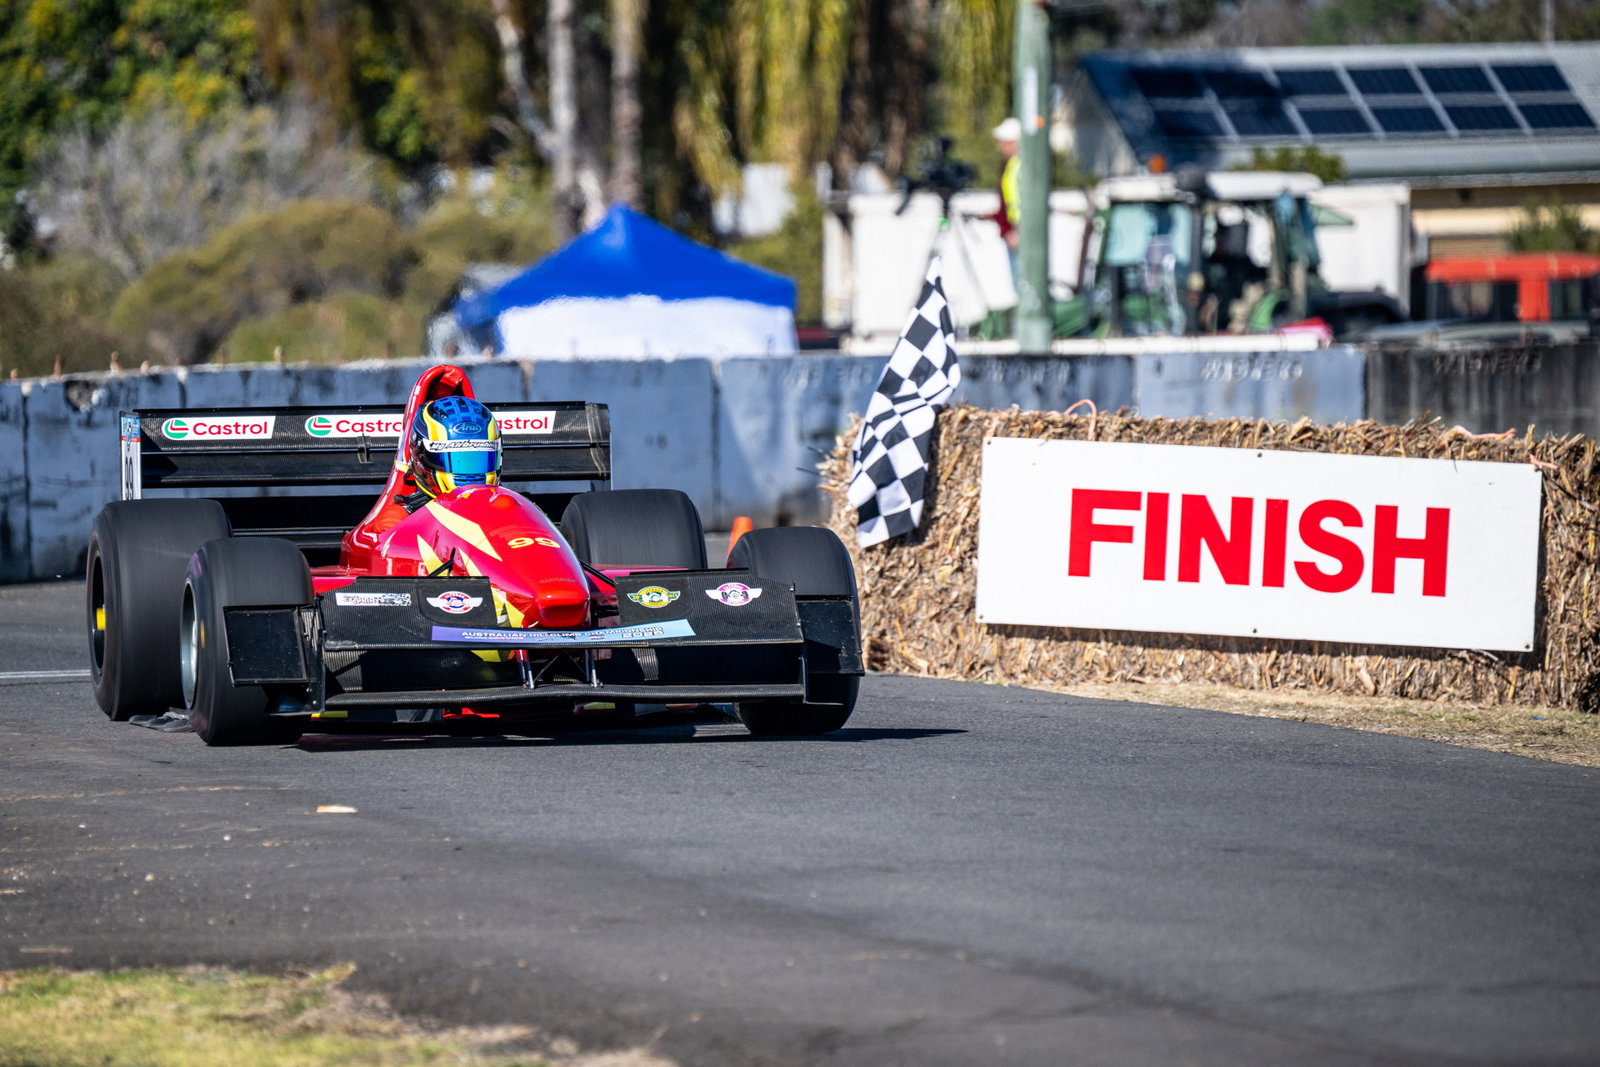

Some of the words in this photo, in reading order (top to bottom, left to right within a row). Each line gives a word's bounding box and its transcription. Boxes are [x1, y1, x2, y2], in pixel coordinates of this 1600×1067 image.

[193, 421, 268, 436] Castrol
[336, 419, 402, 433] Castro
[457, 422, 479, 431] Arai
[495, 416, 548, 430] astrol
[507, 537, 561, 549] 99
[1067, 488, 1451, 598] FINISH
[584, 627, 663, 636] CHAMPIONSHIP
